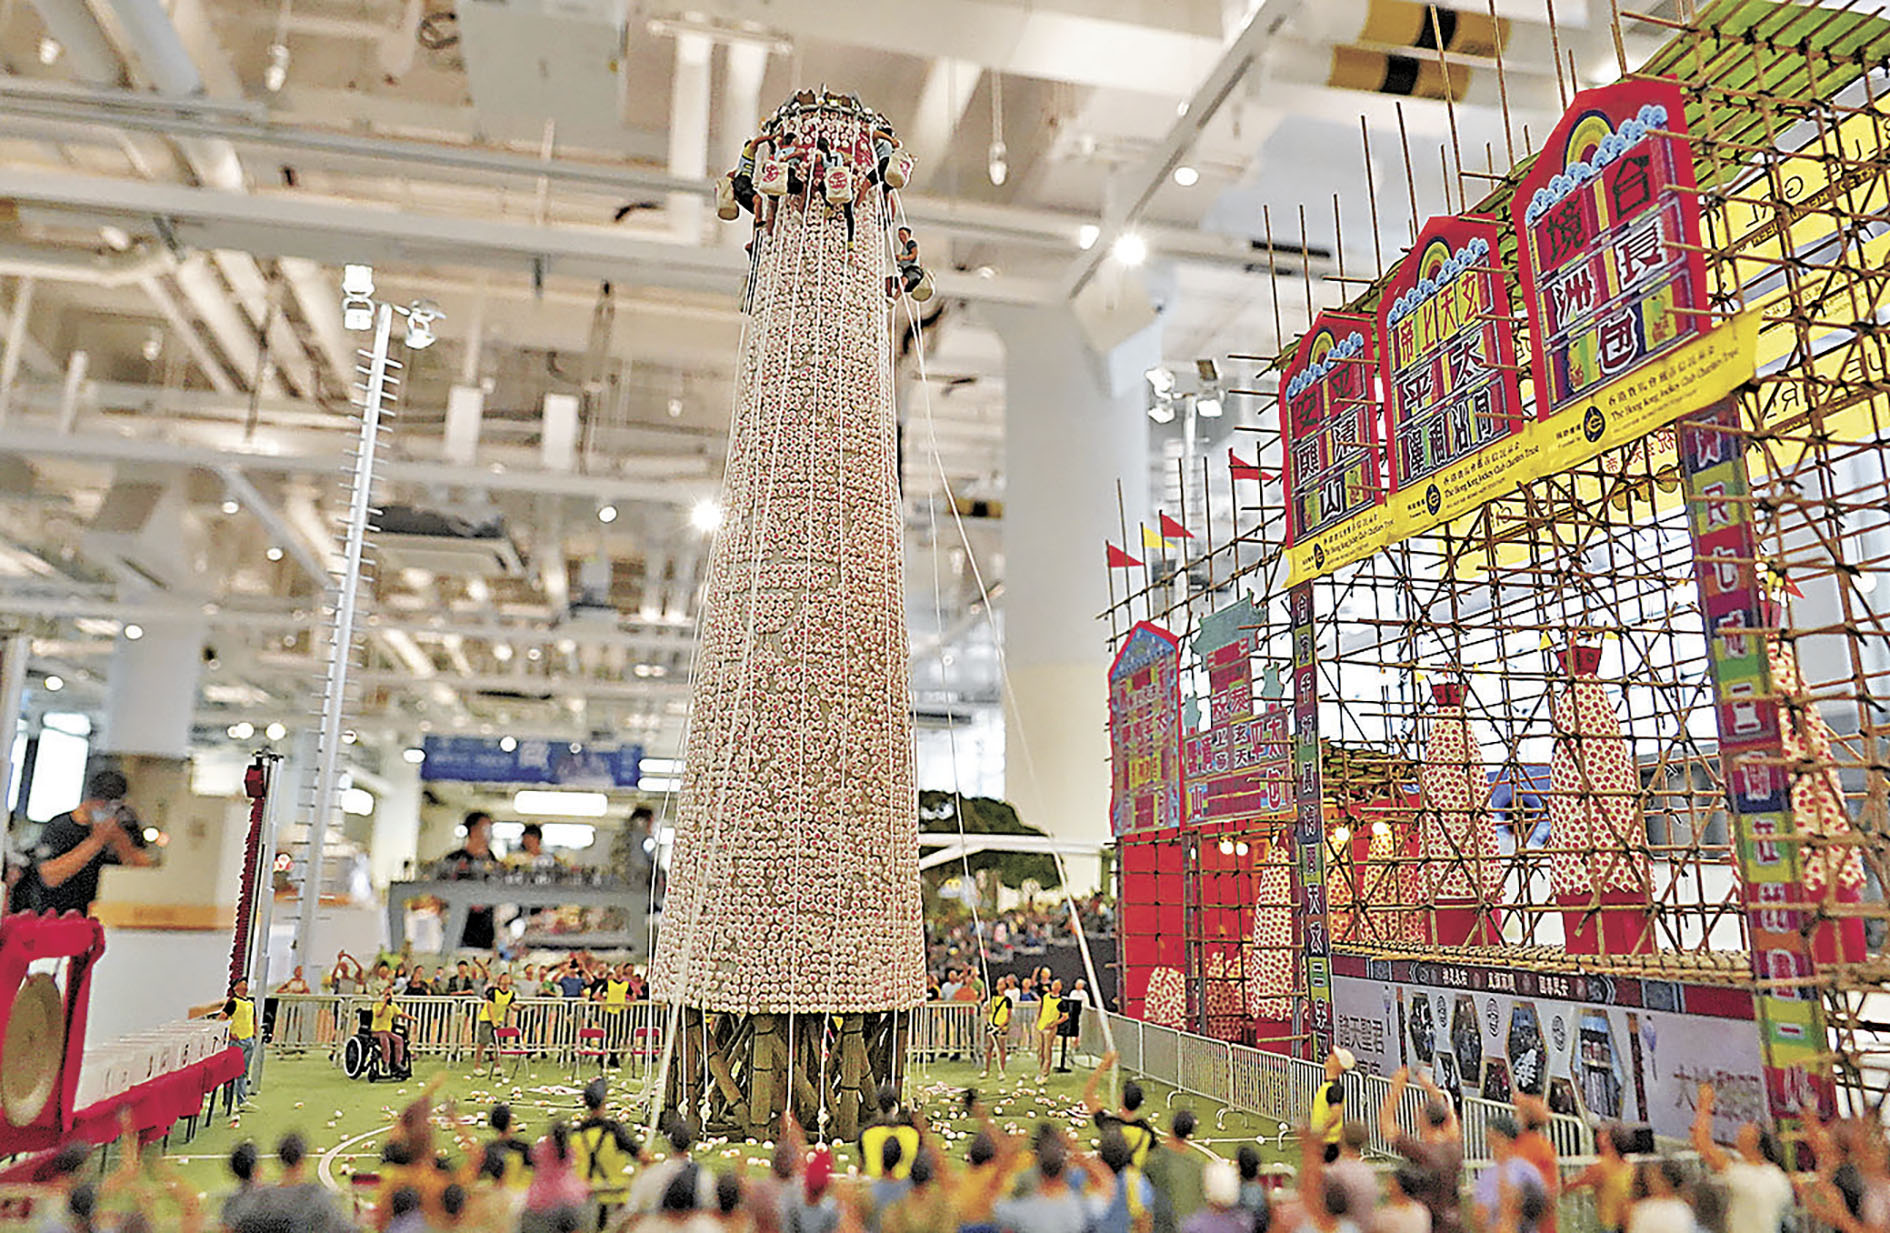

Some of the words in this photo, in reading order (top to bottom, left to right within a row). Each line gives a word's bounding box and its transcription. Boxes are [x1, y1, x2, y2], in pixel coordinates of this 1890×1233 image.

[1400, 272, 1478, 363] 玄天上帝
[1596, 306, 1638, 376] 包
[1403, 333, 1487, 411] 太平
[1319, 480, 1345, 521] 山
